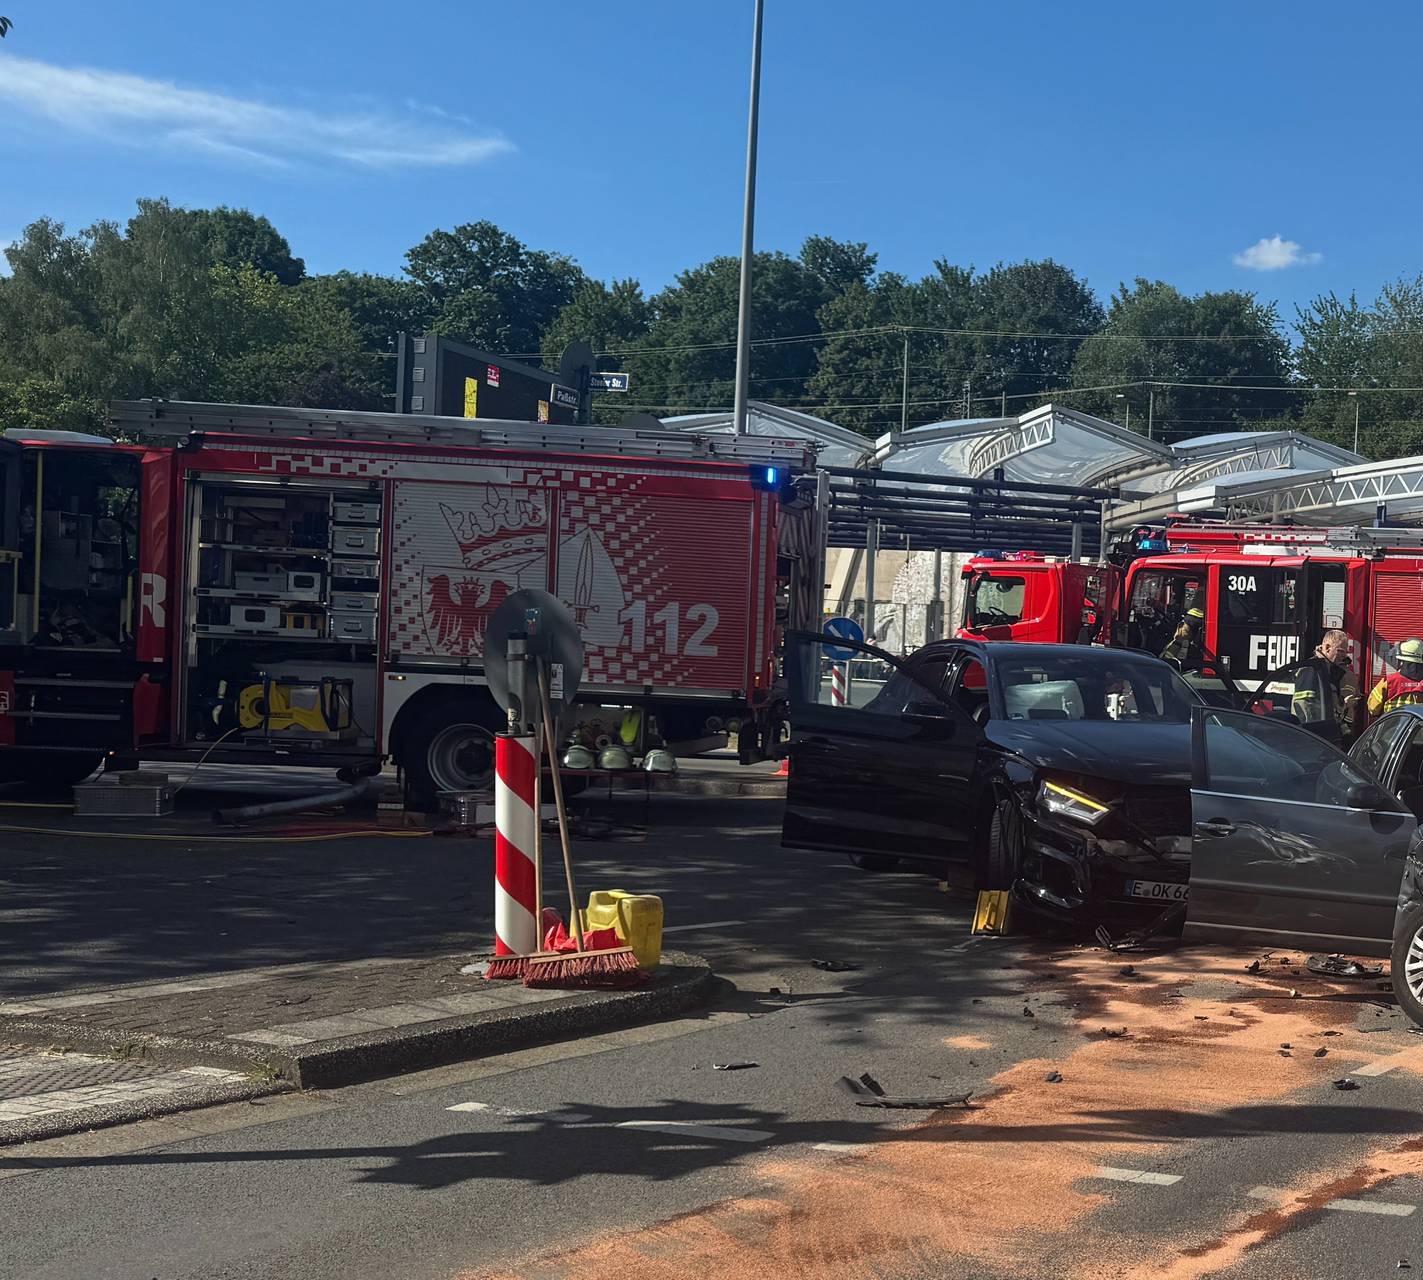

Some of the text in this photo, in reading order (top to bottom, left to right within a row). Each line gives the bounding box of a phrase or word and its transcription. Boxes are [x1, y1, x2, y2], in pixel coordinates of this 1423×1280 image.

[611, 377, 623, 388] Str.
[1228, 575, 1257, 592] 30A
[620, 600, 720, 657] 112
[1133, 882, 1143, 895] E
[1152, 884, 1172, 898] OK
